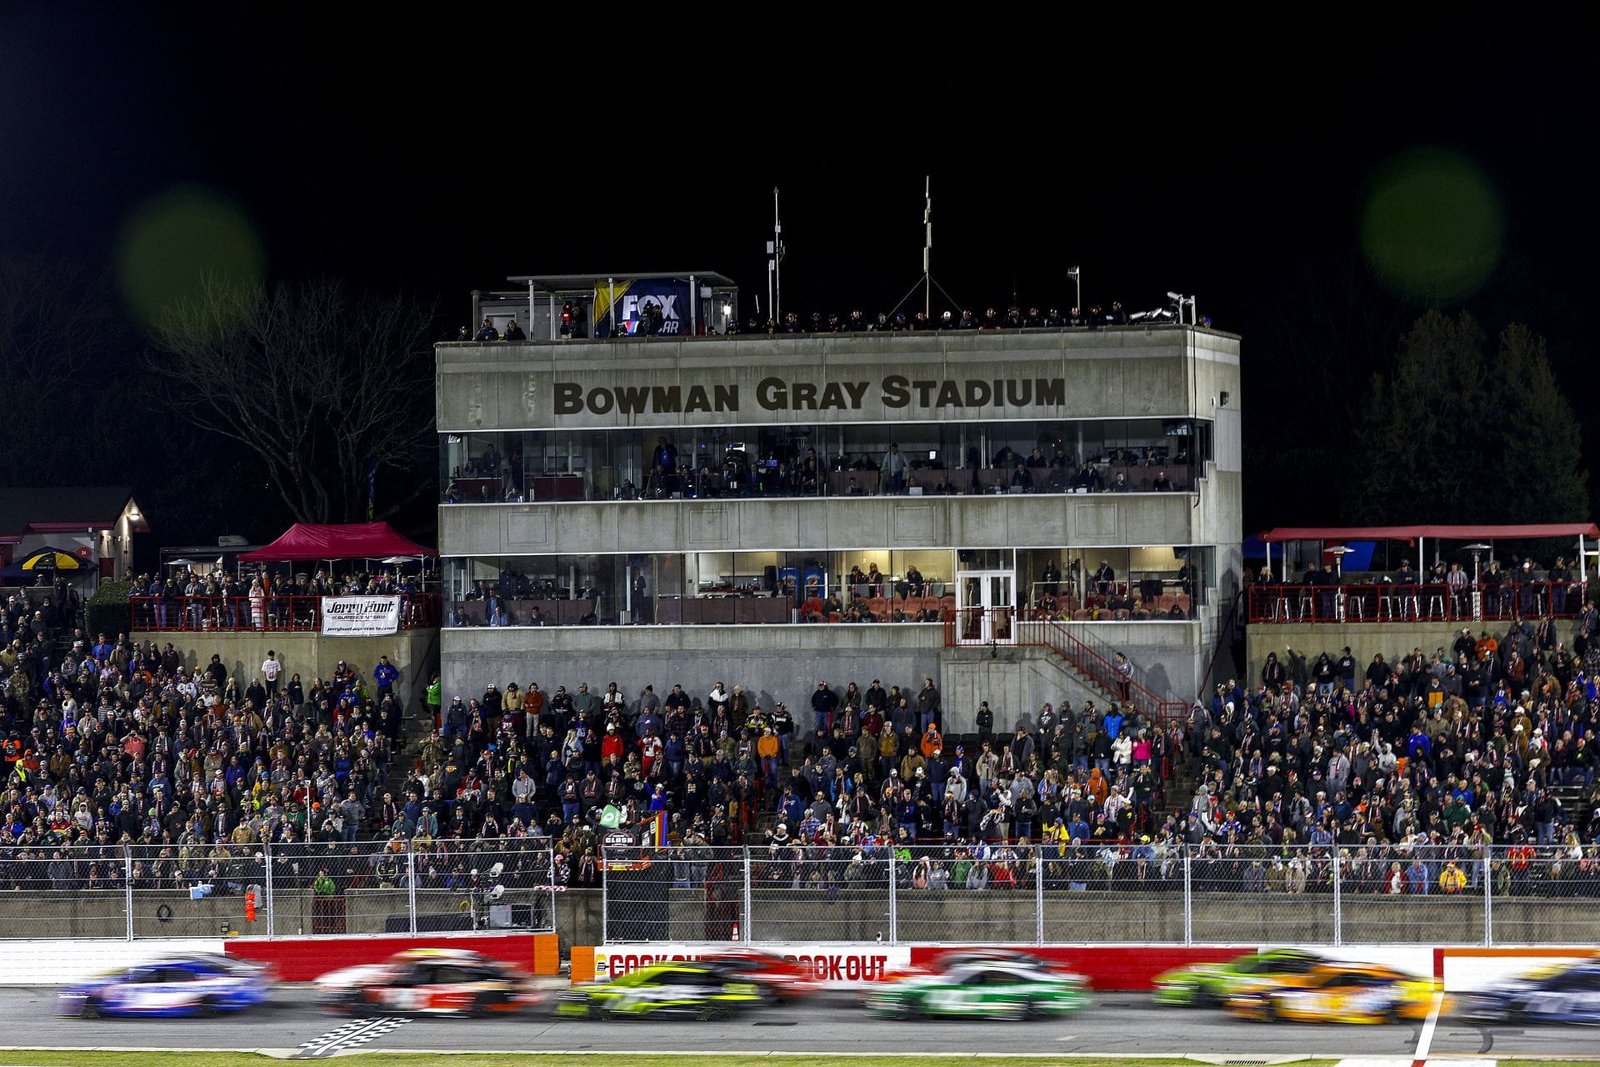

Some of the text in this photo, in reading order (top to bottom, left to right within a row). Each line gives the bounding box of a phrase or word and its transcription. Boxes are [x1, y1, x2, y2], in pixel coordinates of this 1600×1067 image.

[554, 375, 1066, 415] BOWMAN GRAY STADIUM
[327, 601, 395, 615] Jerry Hunt
[846, 955, 887, 981] OUT
